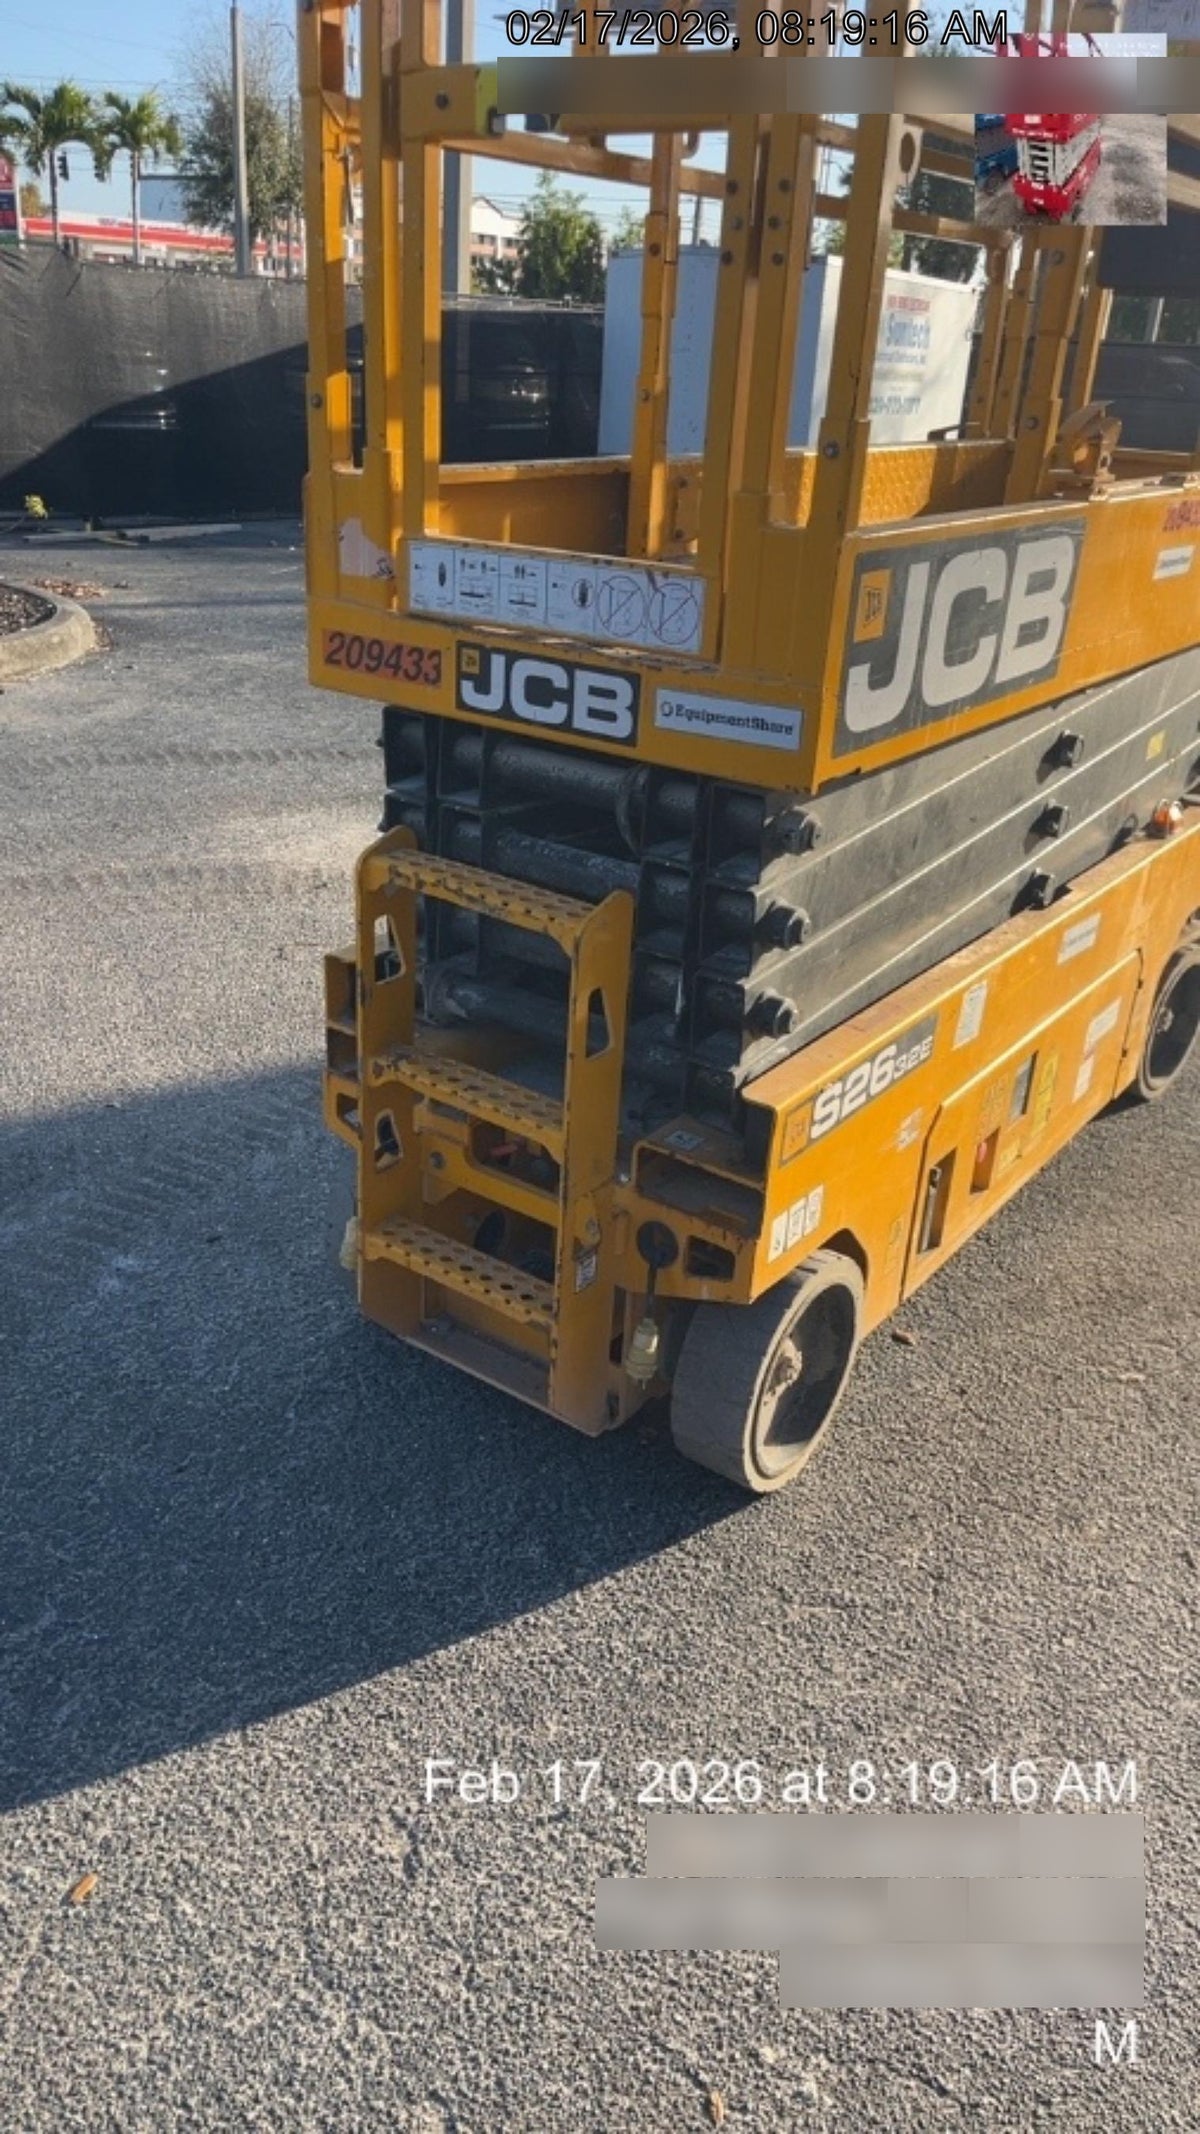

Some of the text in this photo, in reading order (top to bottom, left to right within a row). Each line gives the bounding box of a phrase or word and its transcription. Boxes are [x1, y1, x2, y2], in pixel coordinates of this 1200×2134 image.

[324, 631, 442, 686] 209433
[845, 535, 1075, 733] JCB
[460, 654, 634, 739] JCB
[675, 704, 793, 736] EquipmentShare
[810, 1044, 898, 1139] S26
